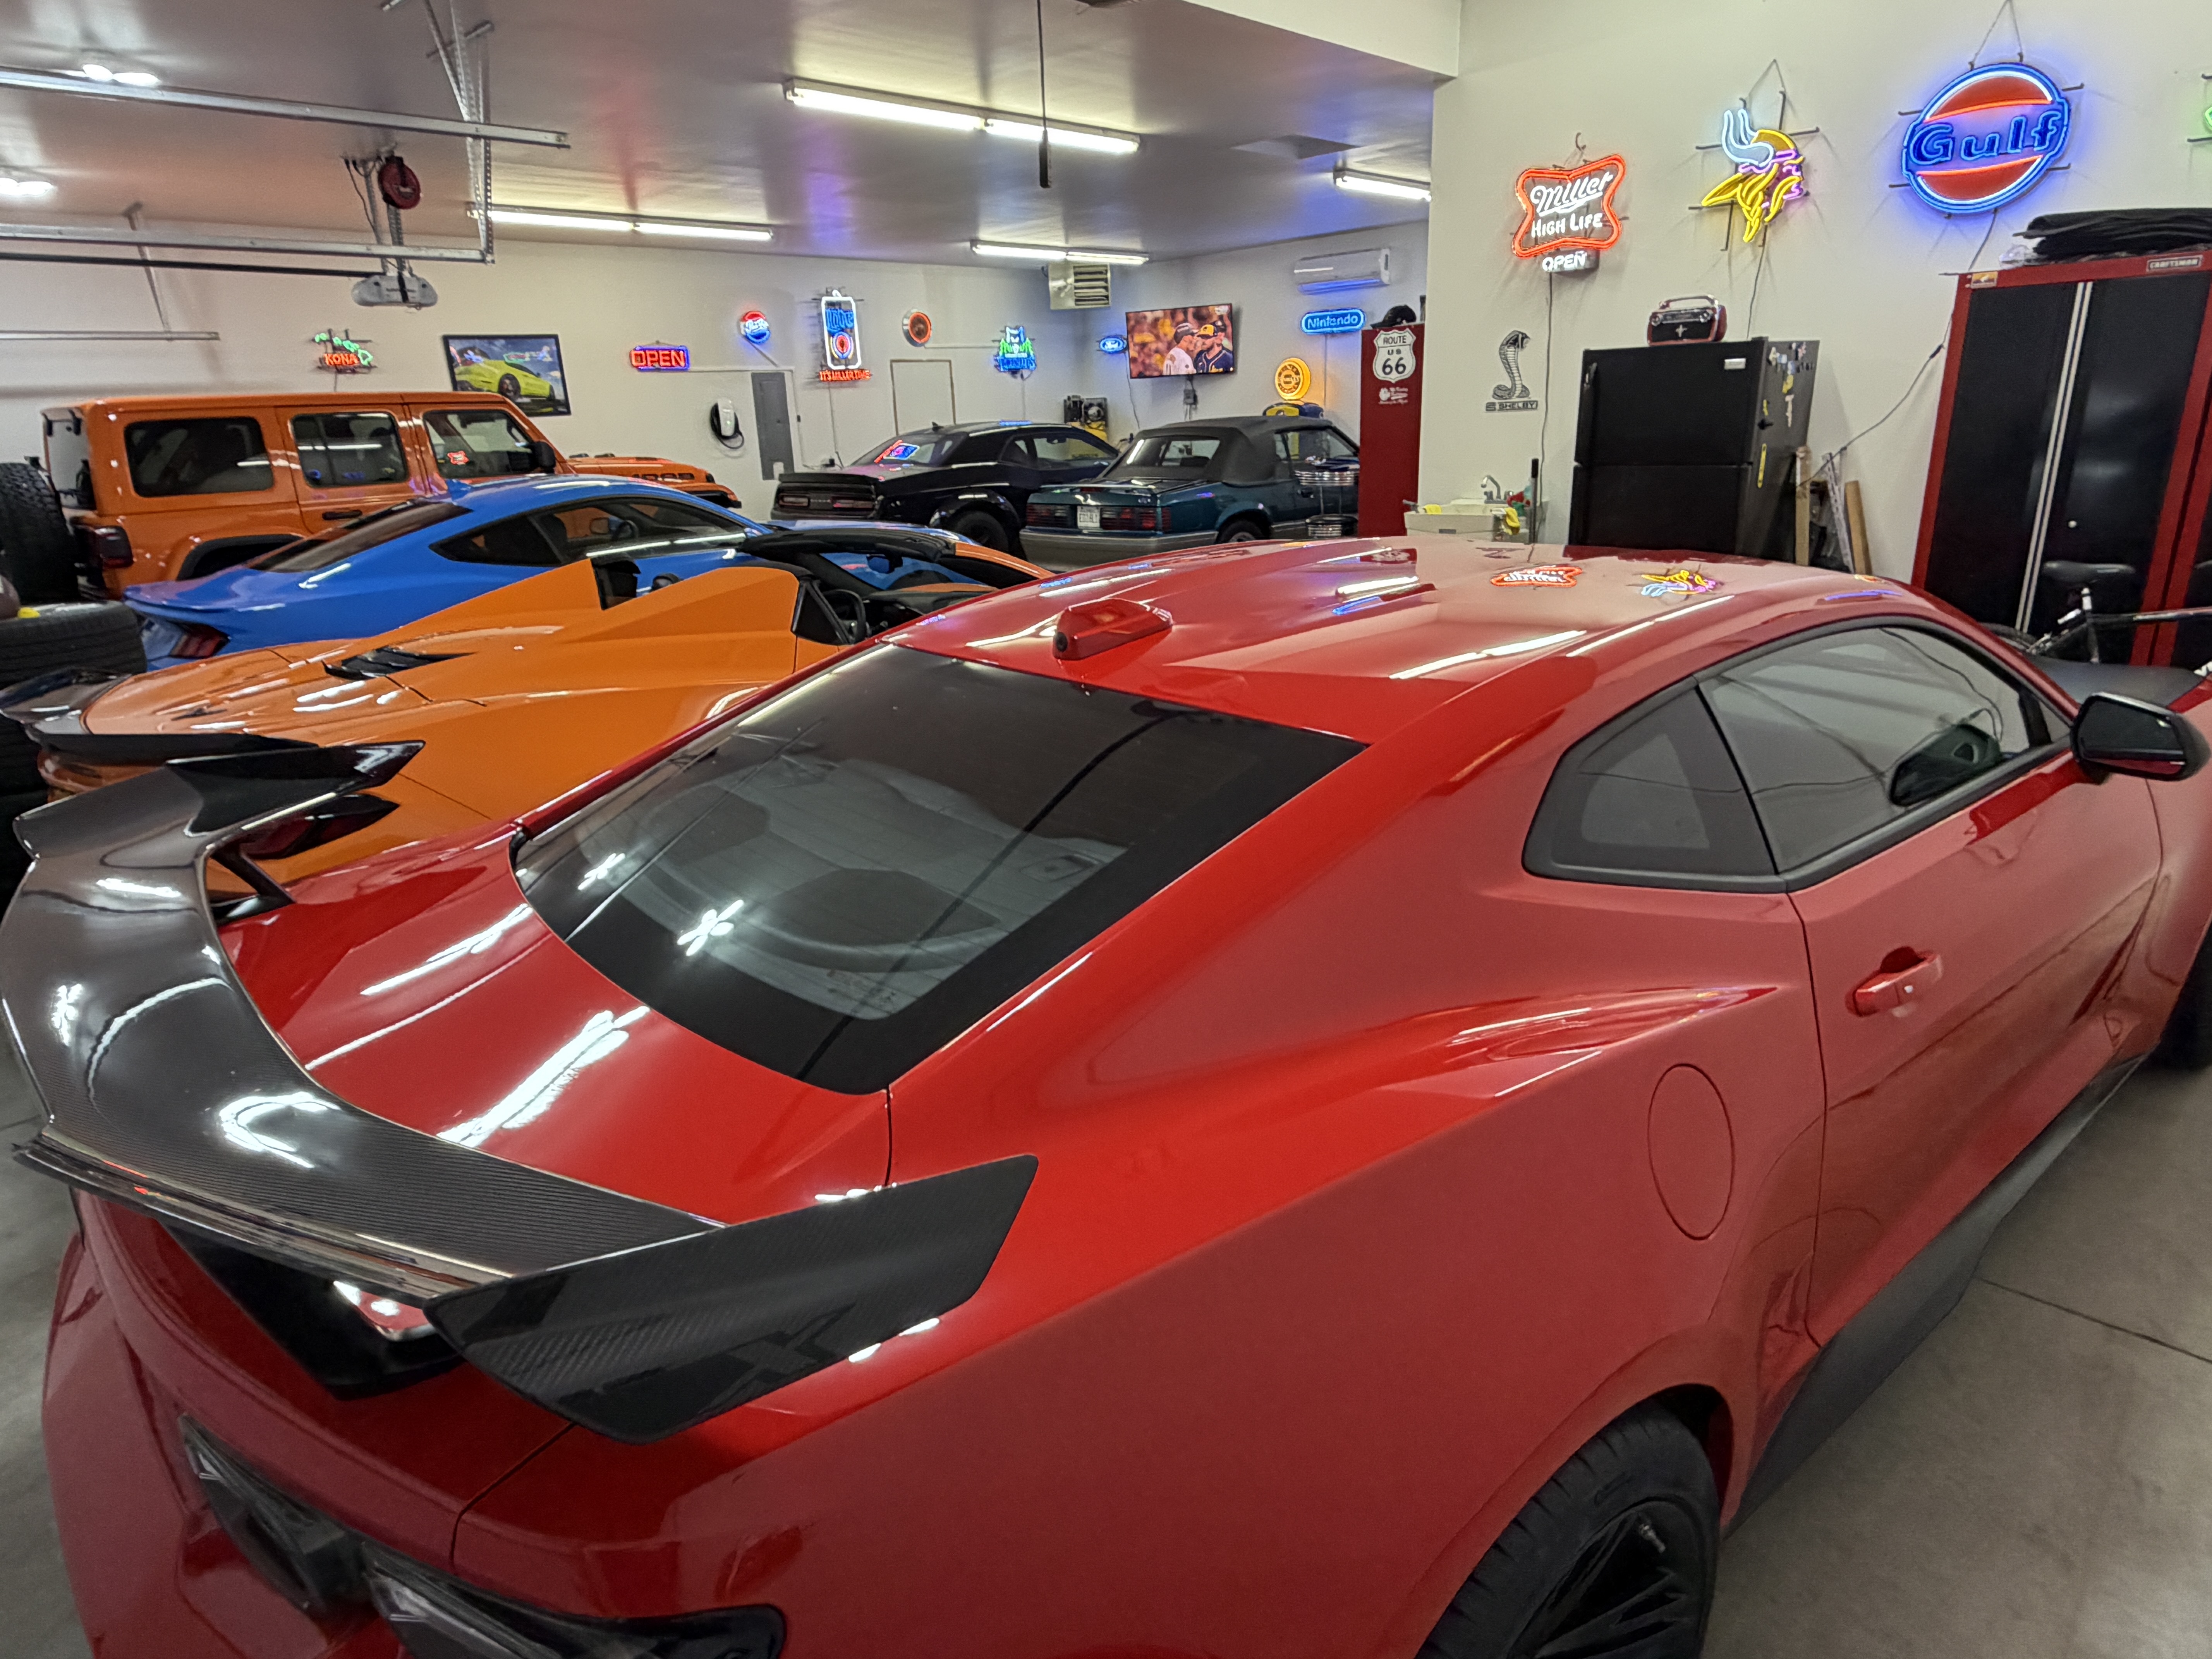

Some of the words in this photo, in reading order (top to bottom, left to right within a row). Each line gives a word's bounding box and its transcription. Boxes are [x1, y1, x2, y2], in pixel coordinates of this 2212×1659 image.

[1908, 111, 2063, 166] Gulf
[1530, 171, 1613, 212] Miller
[1542, 251, 1587, 271] OPEN
[1307, 313, 1358, 329] Nintendo
[1383, 335, 1407, 345] ROUTE
[324, 353, 359, 366] KONA
[631, 350, 686, 368] OPEN
[1381, 358, 1407, 376] 66
